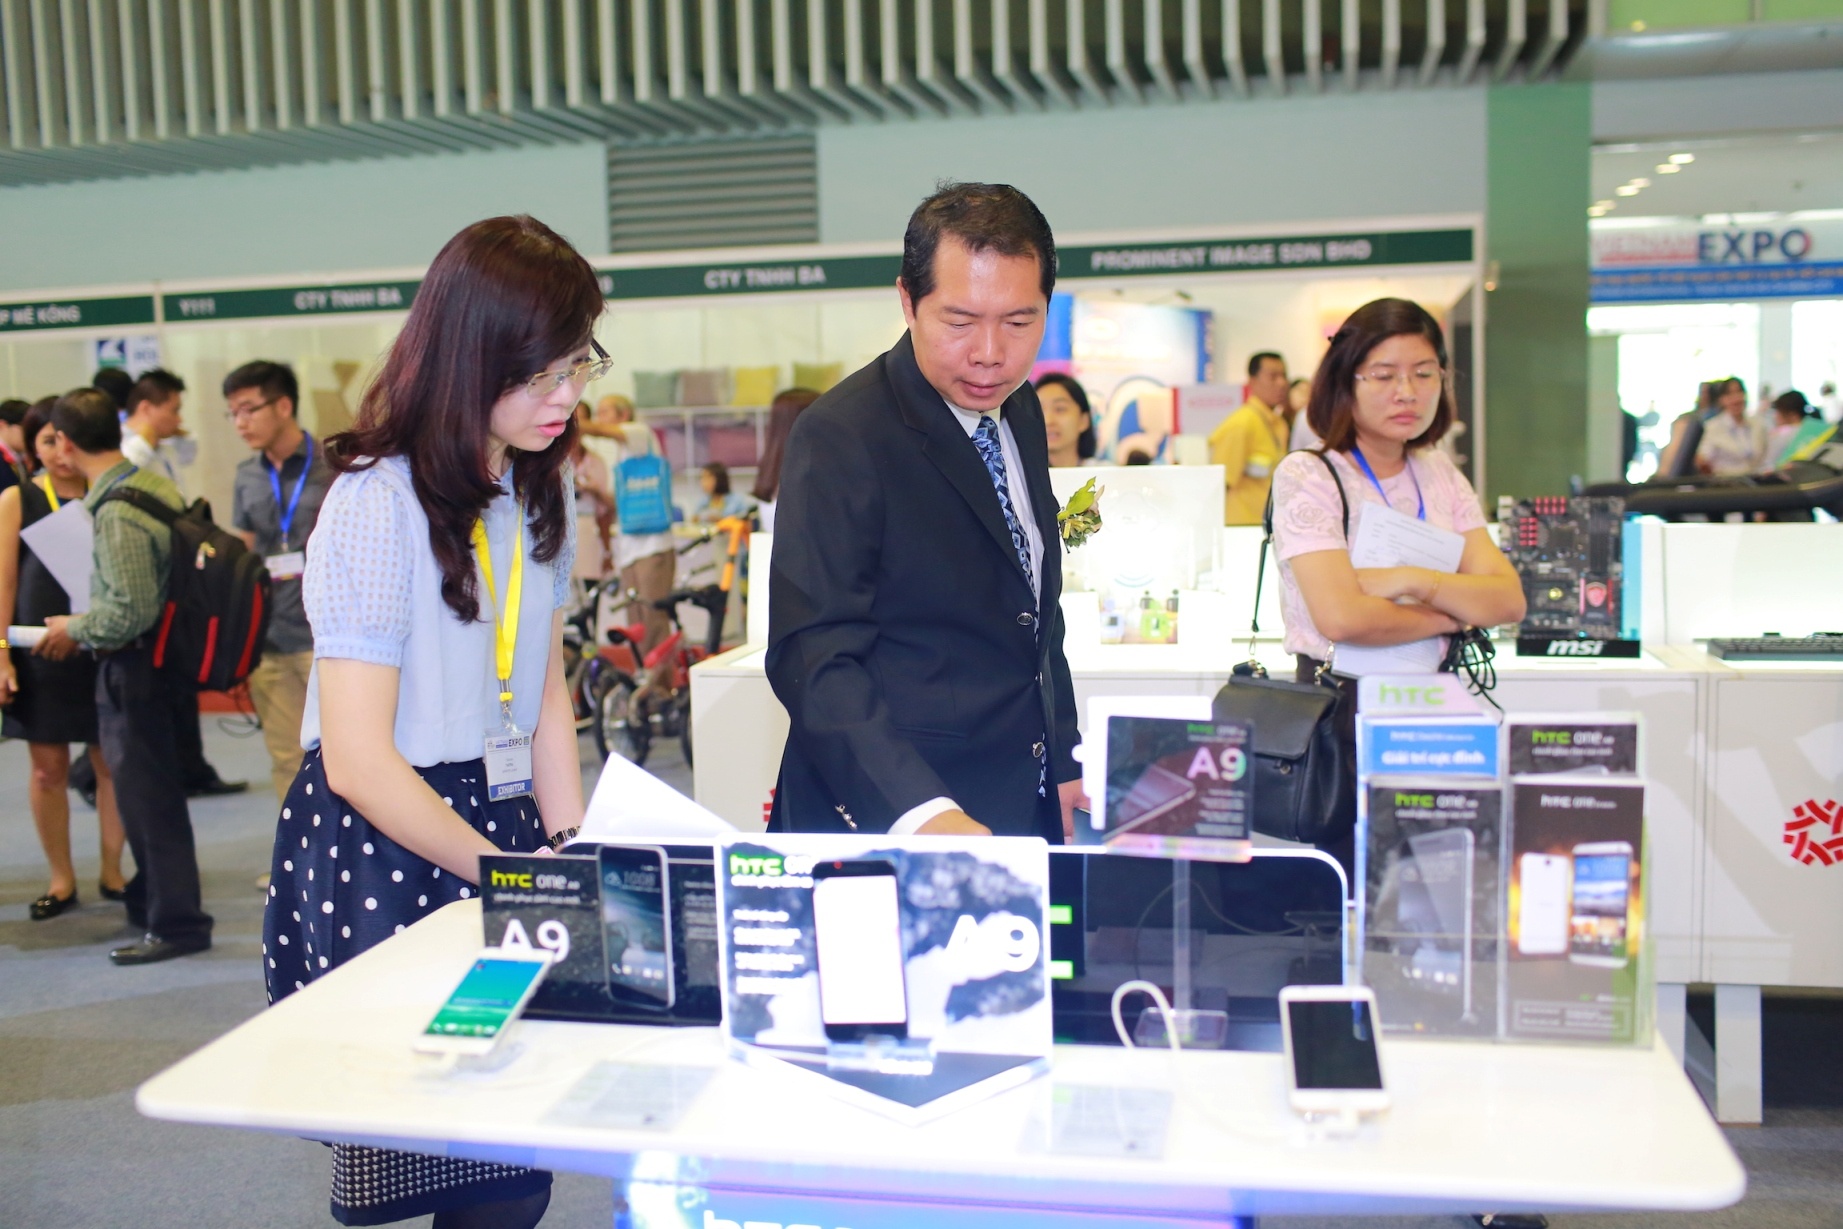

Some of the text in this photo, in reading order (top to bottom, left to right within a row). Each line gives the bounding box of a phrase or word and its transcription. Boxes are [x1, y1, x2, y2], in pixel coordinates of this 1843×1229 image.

[1091, 239, 1373, 271] PROMINENT IMAGE SDN BHD
[1698, 229, 1812, 263] EXPO
[703, 264, 828, 290] CTY TNHH BA
[1548, 639, 1605, 655] msi
[508, 737, 523, 748] EXPO
[1186, 746, 1247, 782] A9
[497, 782, 526, 796] EXHIBITOR
[729, 853, 782, 877] htc
[491, 869, 533, 888] htc
[535, 873, 567, 890] one
[499, 918, 570, 963] A9
